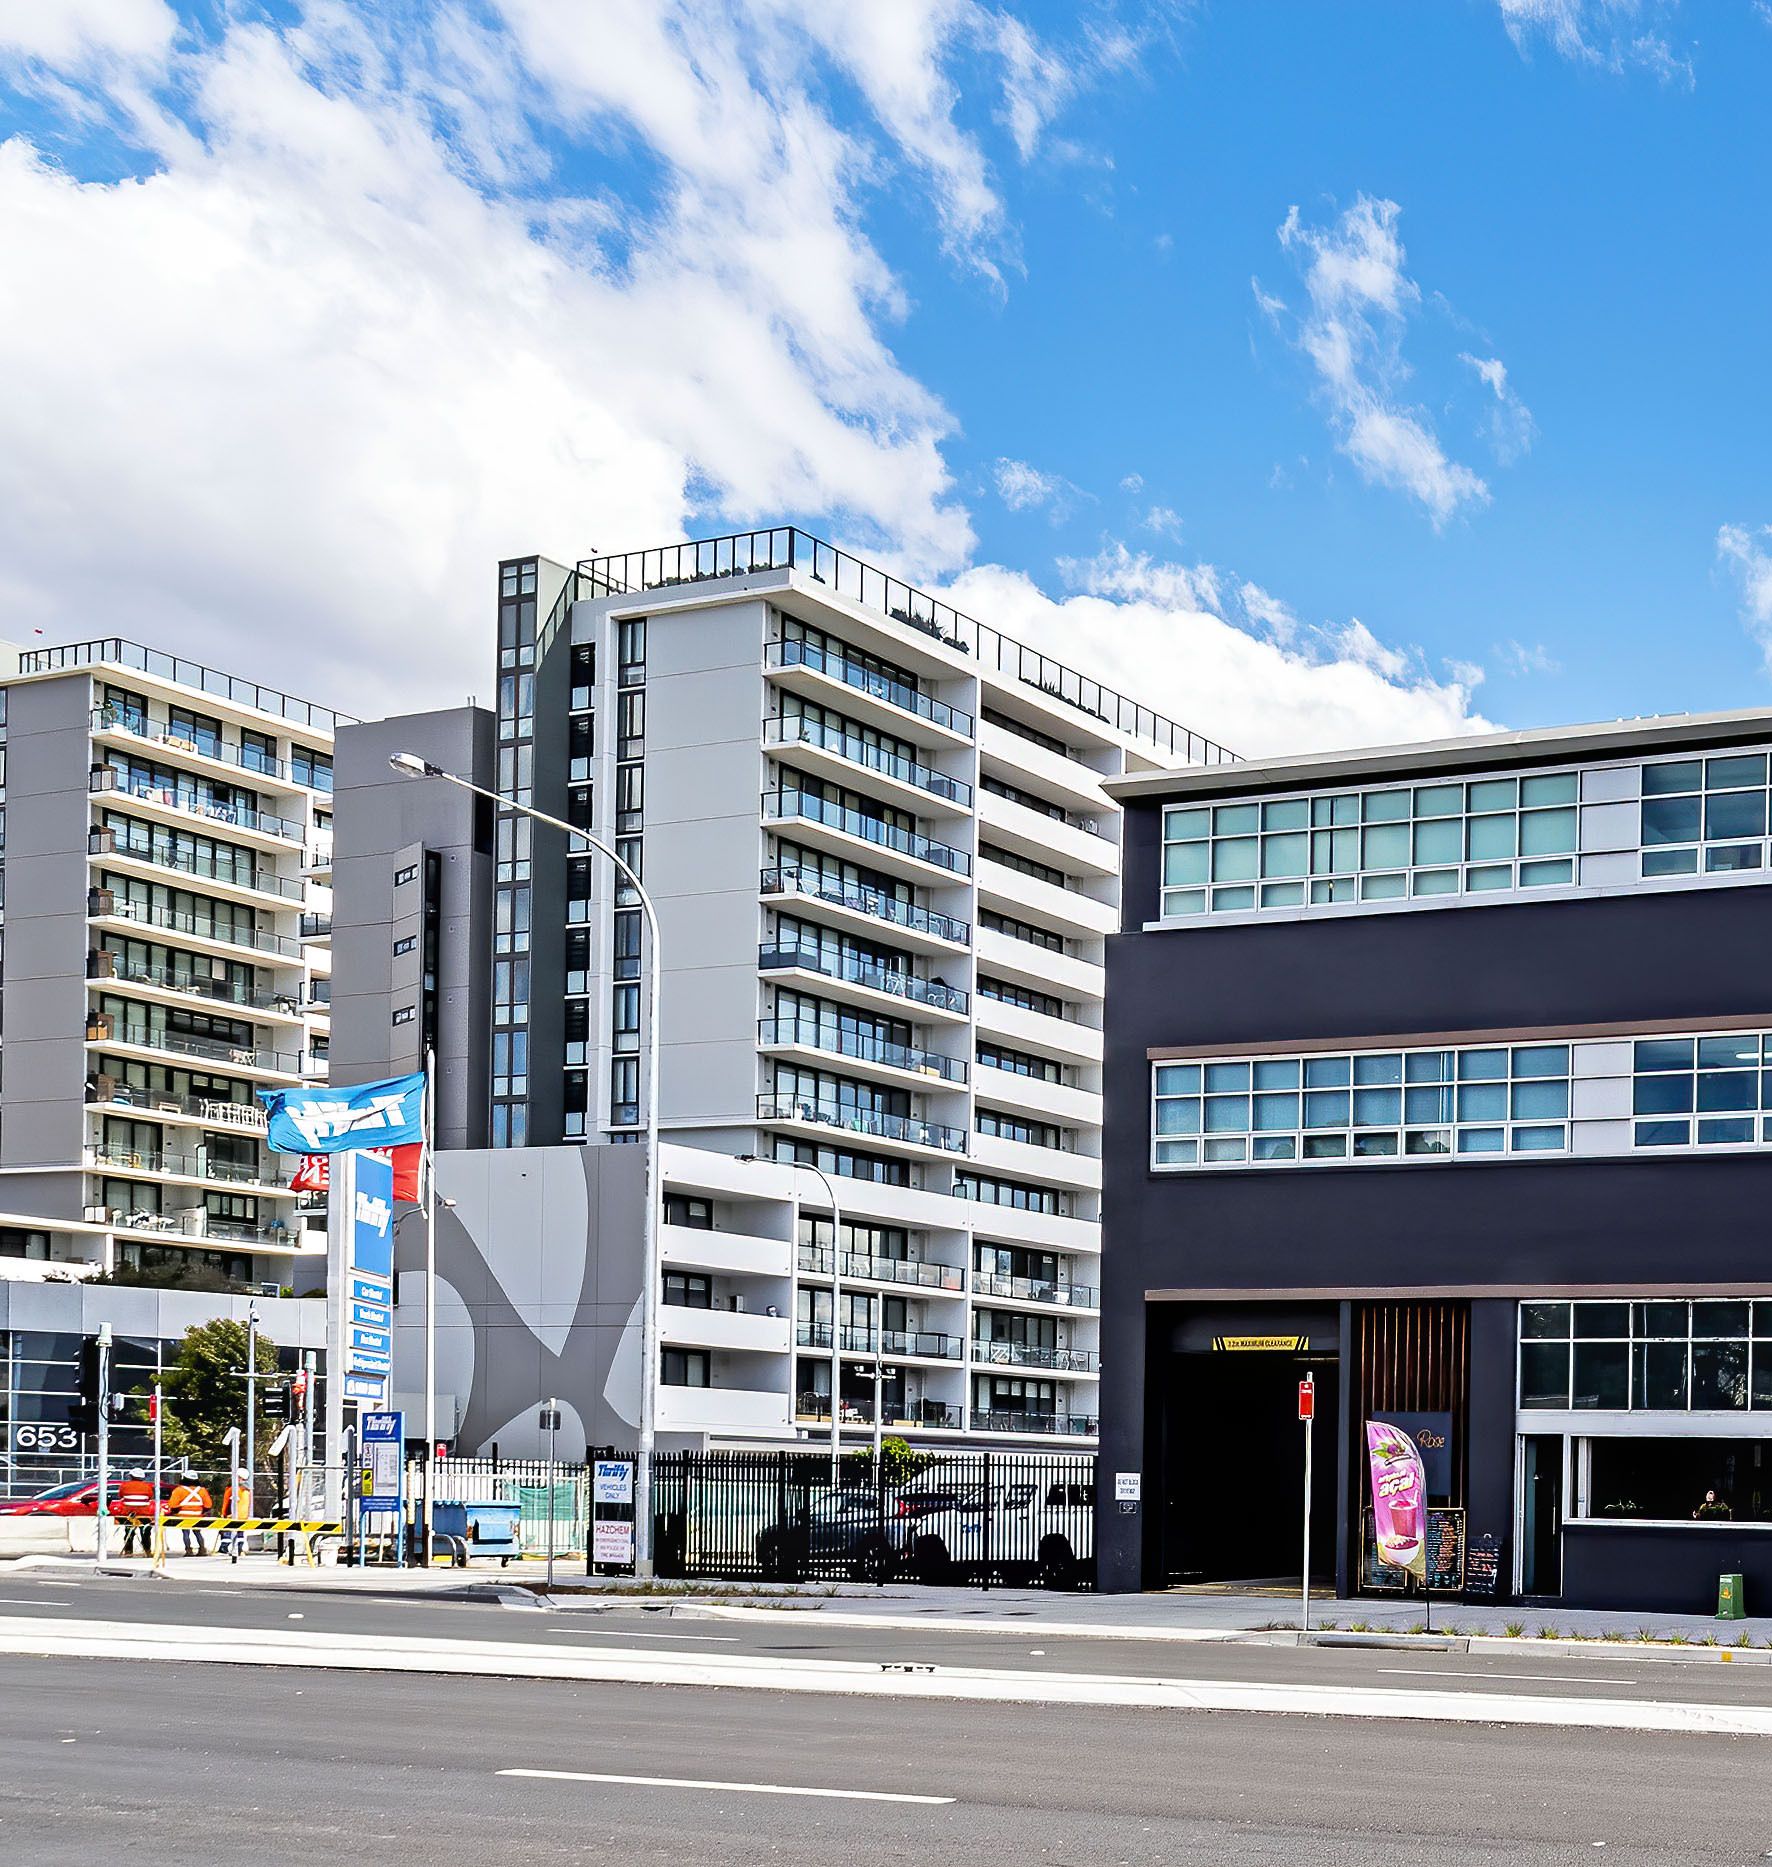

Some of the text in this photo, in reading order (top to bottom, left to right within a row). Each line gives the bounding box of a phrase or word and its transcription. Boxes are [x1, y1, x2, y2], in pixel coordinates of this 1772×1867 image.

[16, 1425, 78, 1448] 653
[598, 1464, 629, 1481] Thrifty
[596, 1525, 629, 1535] HAZCHEM
